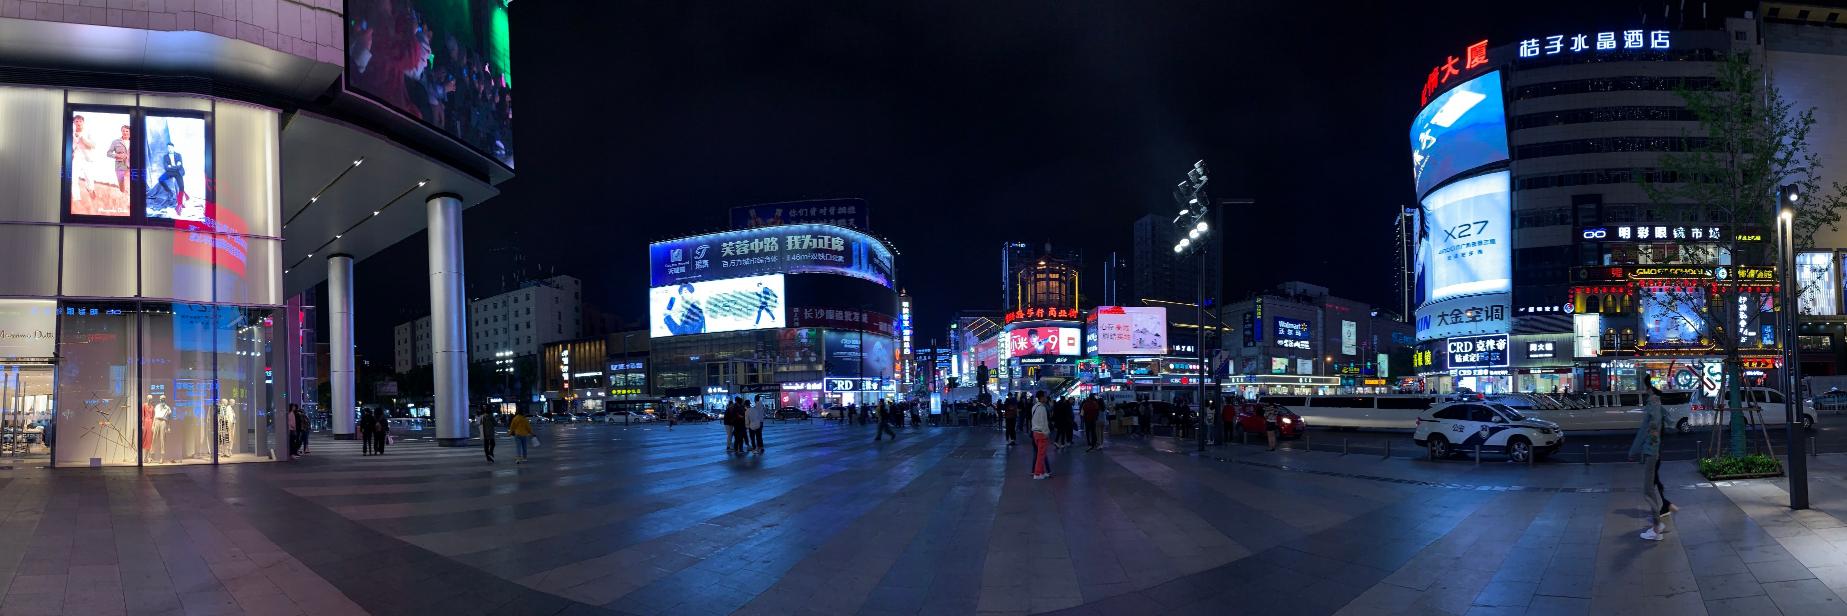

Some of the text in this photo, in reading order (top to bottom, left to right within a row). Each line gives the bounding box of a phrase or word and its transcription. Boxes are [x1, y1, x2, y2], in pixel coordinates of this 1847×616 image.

[1519, 30, 1671, 58] 桔子水晶酒店
[1443, 220, 1489, 243] X27
[1618, 226, 1721, 240] 明彩眼镜市场
[721, 236, 779, 257] 芙蓉中路
[1437, 305, 1504, 326] 大金空调
[1278, 320, 1301, 330] Walmart
[1278, 328, 1302, 337] 沃尔玛
[1010, 335, 1059, 351] 小米 9
[1448, 341, 1473, 354] CRD
[1450, 423, 1464, 433] 公安
